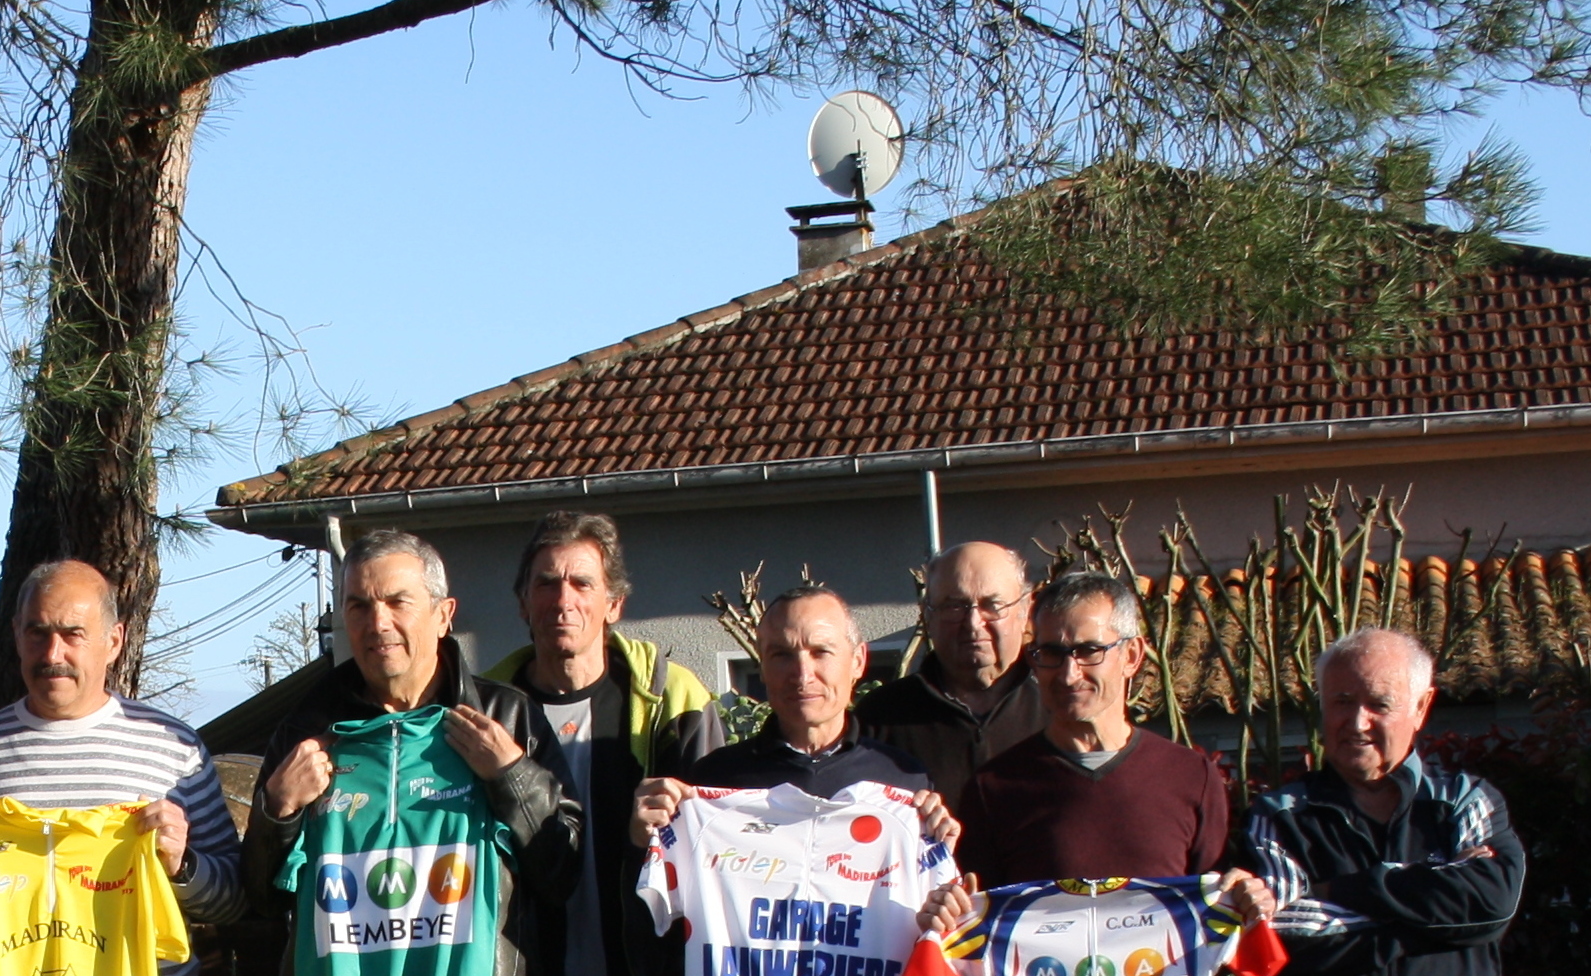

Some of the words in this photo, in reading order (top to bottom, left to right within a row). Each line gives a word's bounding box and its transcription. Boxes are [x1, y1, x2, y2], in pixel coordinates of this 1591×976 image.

[703, 847, 788, 886] ufolep
[0, 919, 108, 959] MADIRAN
[329, 913, 454, 945] LEMBEYE
[748, 897, 863, 948] GARAGE
